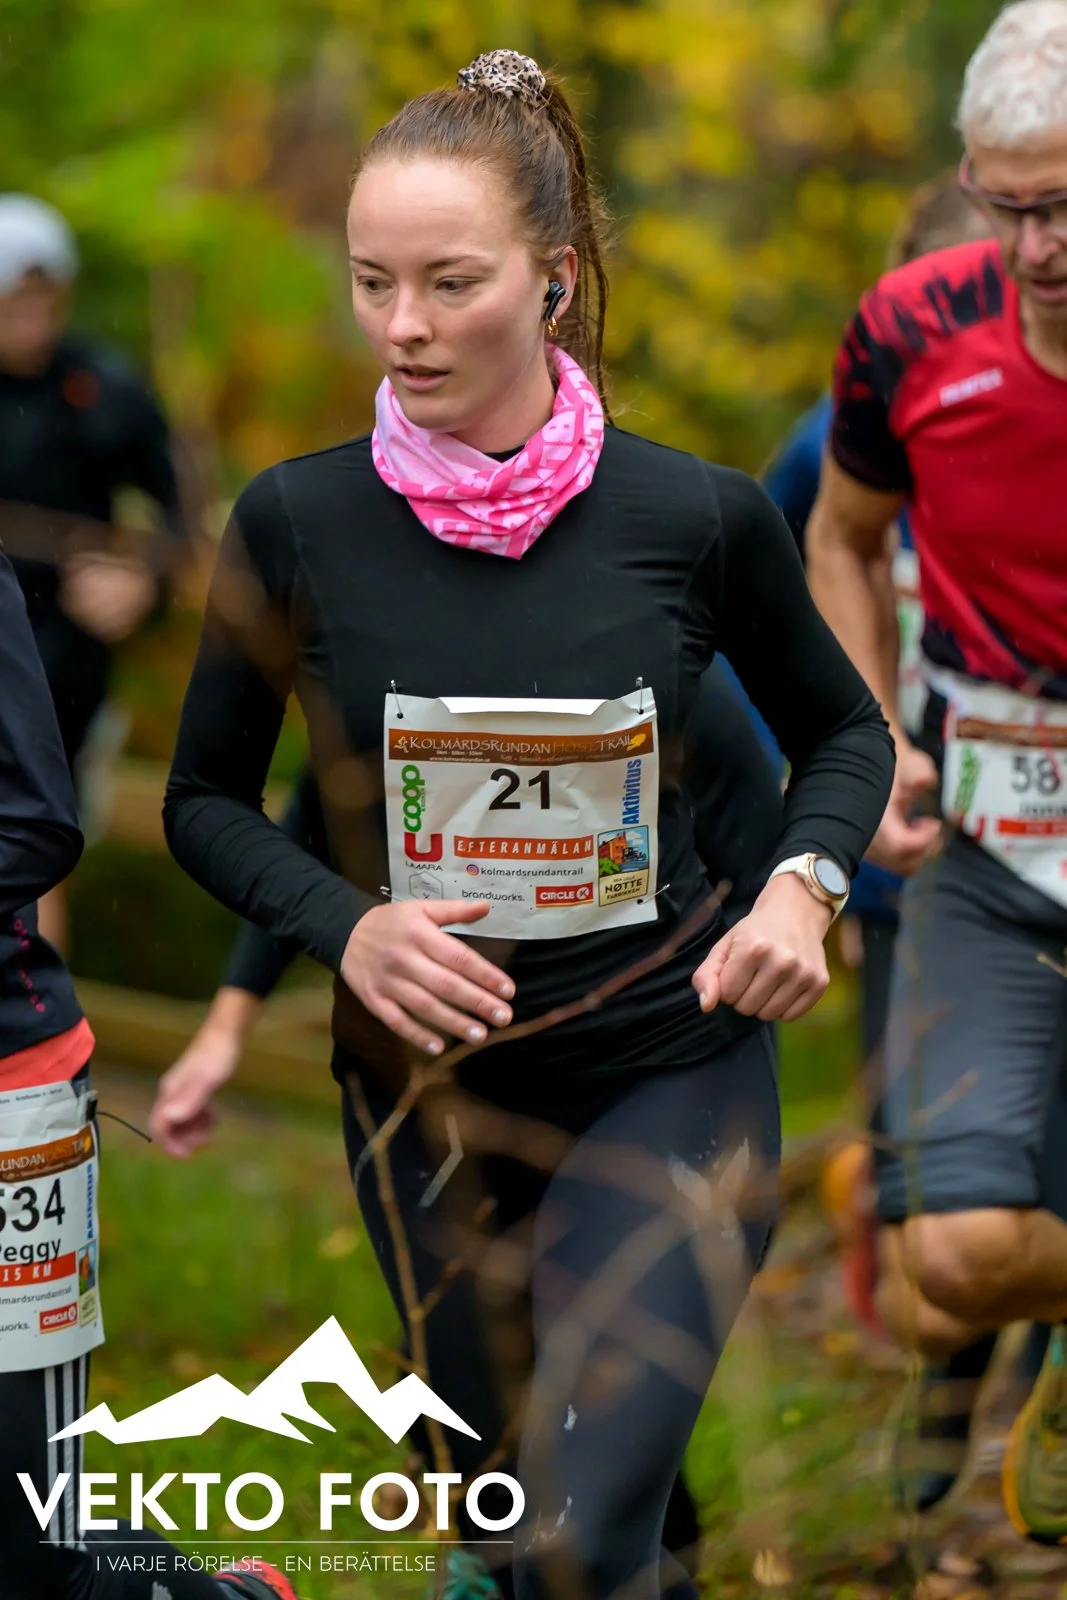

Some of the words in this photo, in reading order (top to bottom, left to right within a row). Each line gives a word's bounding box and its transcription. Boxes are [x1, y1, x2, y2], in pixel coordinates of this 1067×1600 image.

[1011, 755, 1067, 797] 58
[401, 764, 426, 833] coop
[488, 768, 551, 810] 21
[622, 758, 642, 825] Aktivitus
[457, 839, 592, 855] EFTERANMÄLAN
[480, 866, 584, 877] kolmardsrundantrail
[461, 889, 526, 902] brandworks.
[540, 890, 575, 900] CIRCLE
[605, 878, 643, 894] NØTTE
[0, 1153, 45, 1172] UNDAN
[0, 1178, 66, 1233] 34
[0, 1238, 62, 1267] eggy
[3, 1267, 21, 1282] 15
[32, 1263, 52, 1279] KM
